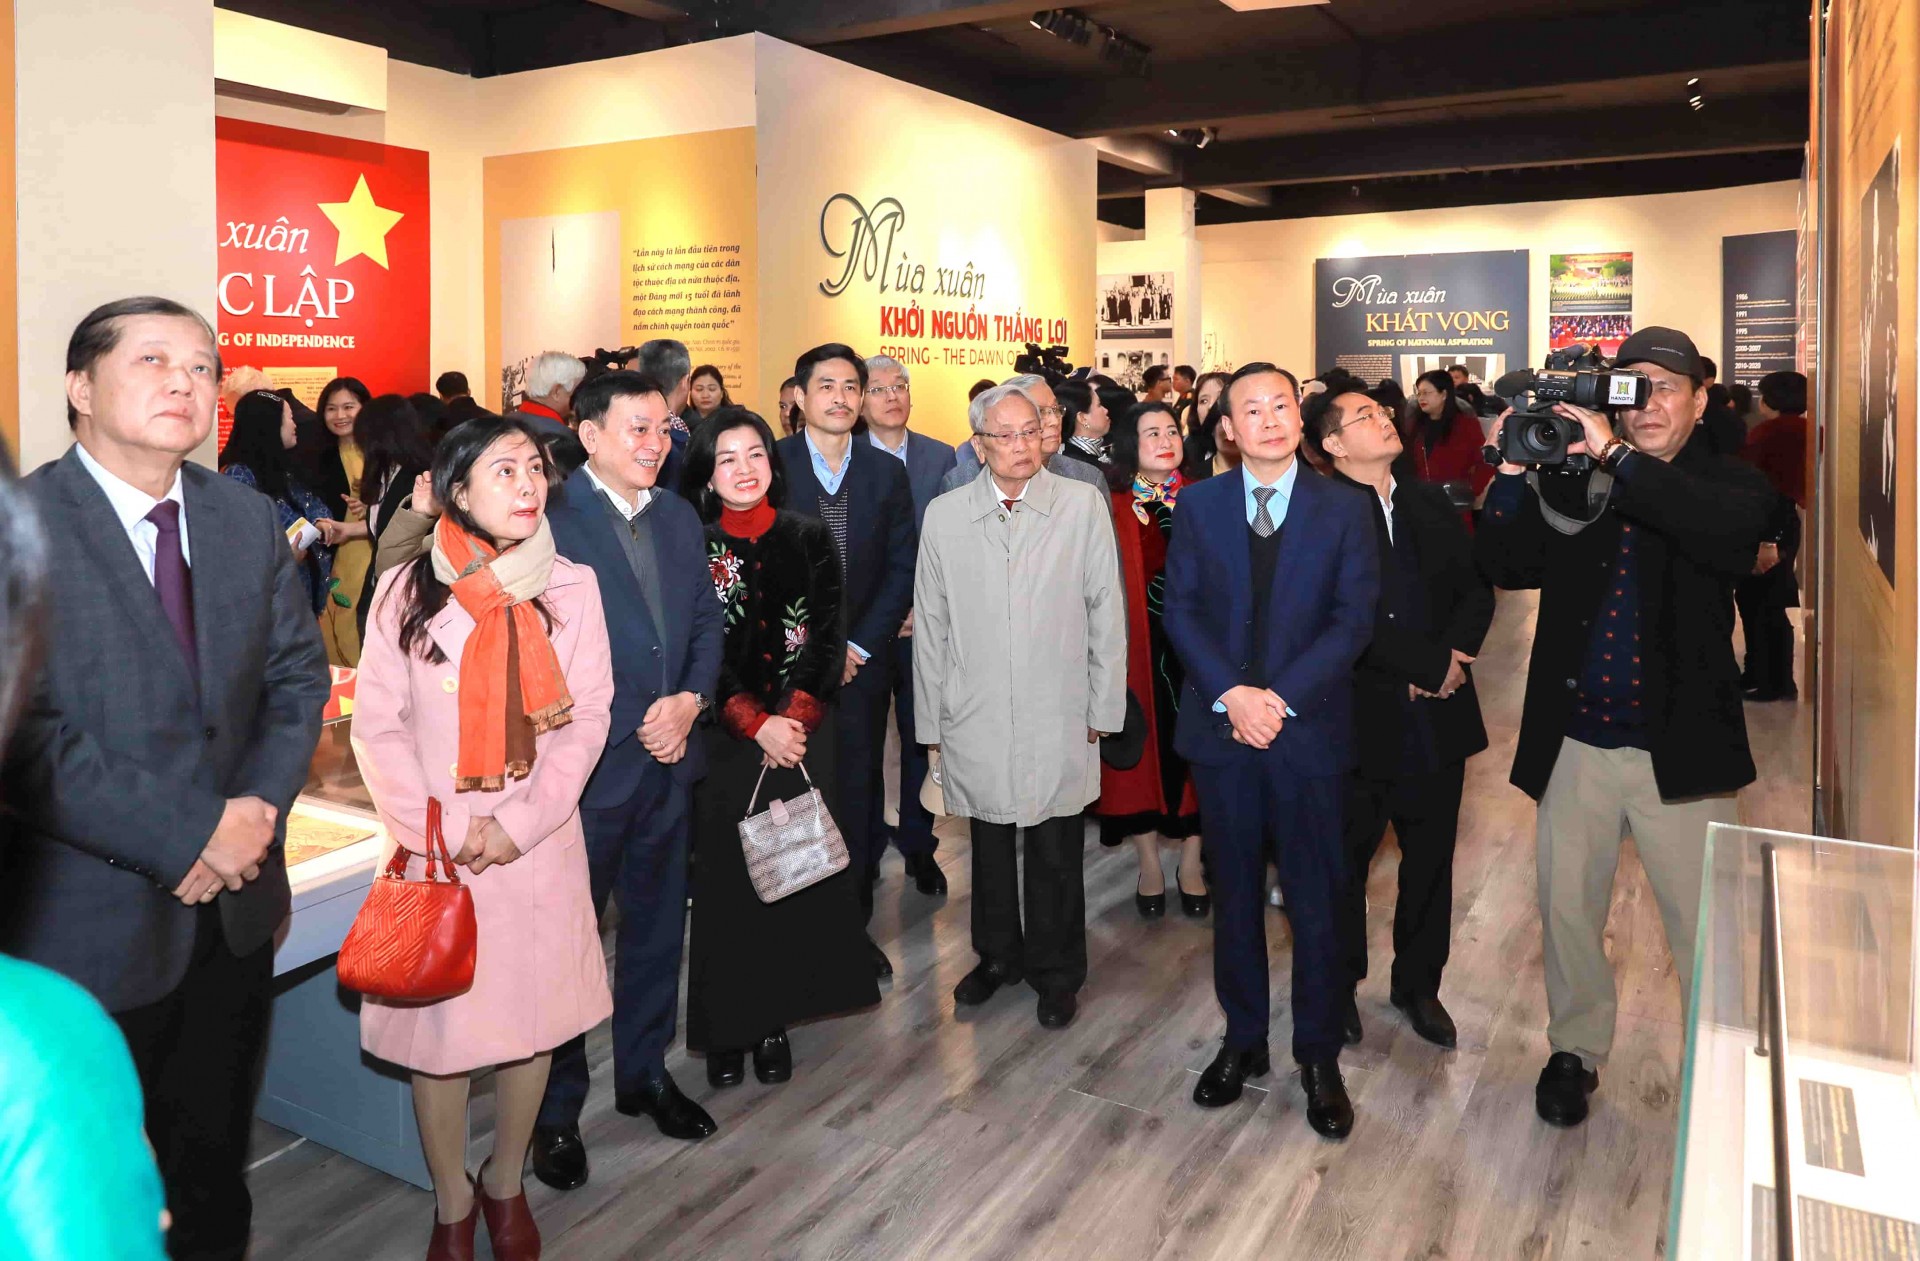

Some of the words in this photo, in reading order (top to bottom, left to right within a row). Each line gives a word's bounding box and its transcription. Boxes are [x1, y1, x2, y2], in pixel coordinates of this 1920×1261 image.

[219, 216, 309, 254] xuân
[651, 249, 664, 257] này
[720, 244, 740, 253] trong
[819, 192, 925, 297] Mùa
[932, 260, 985, 300] xuân
[633, 263, 645, 274] lịch
[657, 262, 672, 271] cách
[675, 262, 695, 271] mạng
[725, 259, 740, 267] dân
[633, 279, 643, 289] tộc
[645, 278, 663, 288] thuộc
[665, 277, 676, 287] địa
[703, 275, 723, 285] thuộc
[262, 264, 355, 327] LẬP
[633, 293, 646, 302] một
[685, 293, 692, 301] 15
[712, 290, 721, 298] đã
[723, 289, 740, 298] lãnh
[1332, 274, 1398, 308] Mùa
[1403, 287, 1446, 303] xuân
[633, 308, 646, 318] đạo
[647, 307, 663, 315] cách
[665, 307, 685, 317] mạng
[686, 306, 707, 314] thành
[731, 305, 741, 313] đã
[650, 322, 669, 330] chính
[694, 321, 710, 329] toàn
[880, 299, 924, 338] KHỞI
[932, 303, 988, 341] NGUỒN
[994, 307, 1042, 344] THẮNG
[1048, 317, 1068, 346] LỢI
[1366, 308, 1433, 332] KHÁT
[1437, 310, 1510, 335] VỌNG
[234, 333, 253, 346] OF
[256, 333, 355, 349] INDEPENDENCE
[1368, 339, 1394, 347] SPRING
[1447, 338, 1493, 346] ASPIRATION
[943, 348, 966, 365] THE
[970, 349, 1004, 365] DAWN
